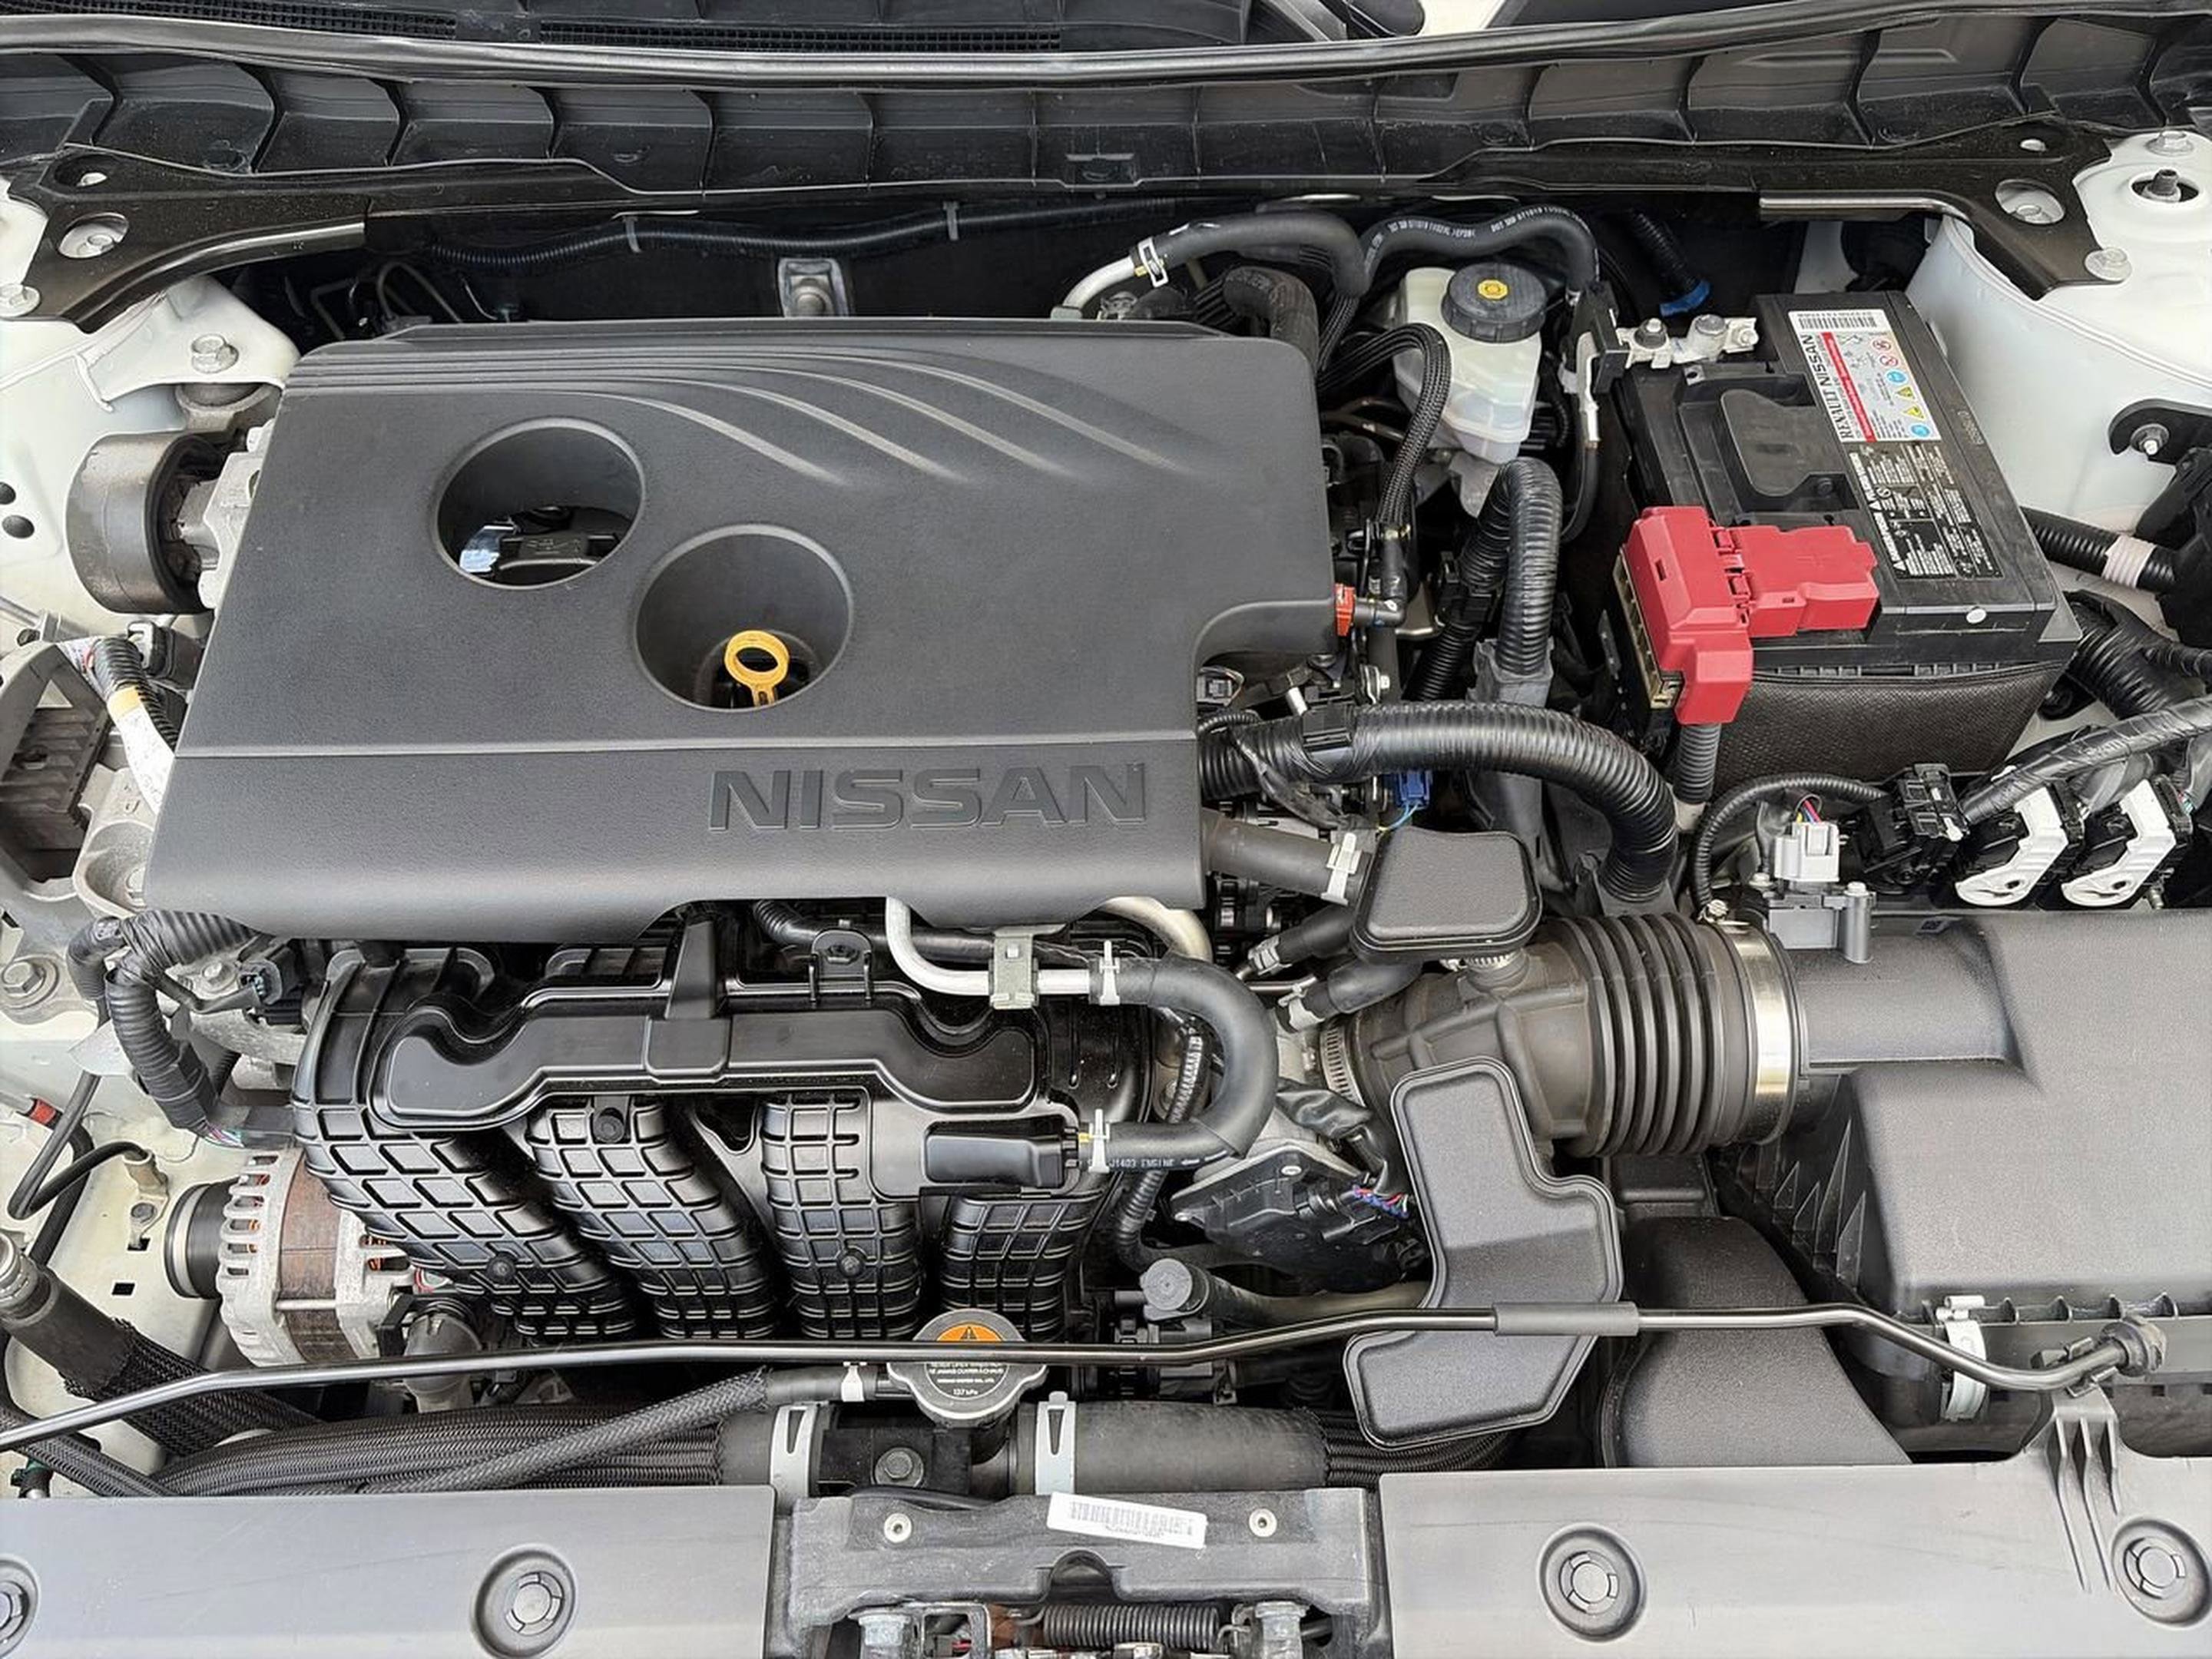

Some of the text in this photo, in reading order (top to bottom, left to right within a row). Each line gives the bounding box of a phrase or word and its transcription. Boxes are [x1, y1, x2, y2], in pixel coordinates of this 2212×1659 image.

[1800, 335, 1832, 386] NISSAN
[1823, 389, 1854, 439] RENAULT
[707, 762, 1147, 832] NISSAN
[1110, 1159, 1175, 1168] J1403 ENGINE
